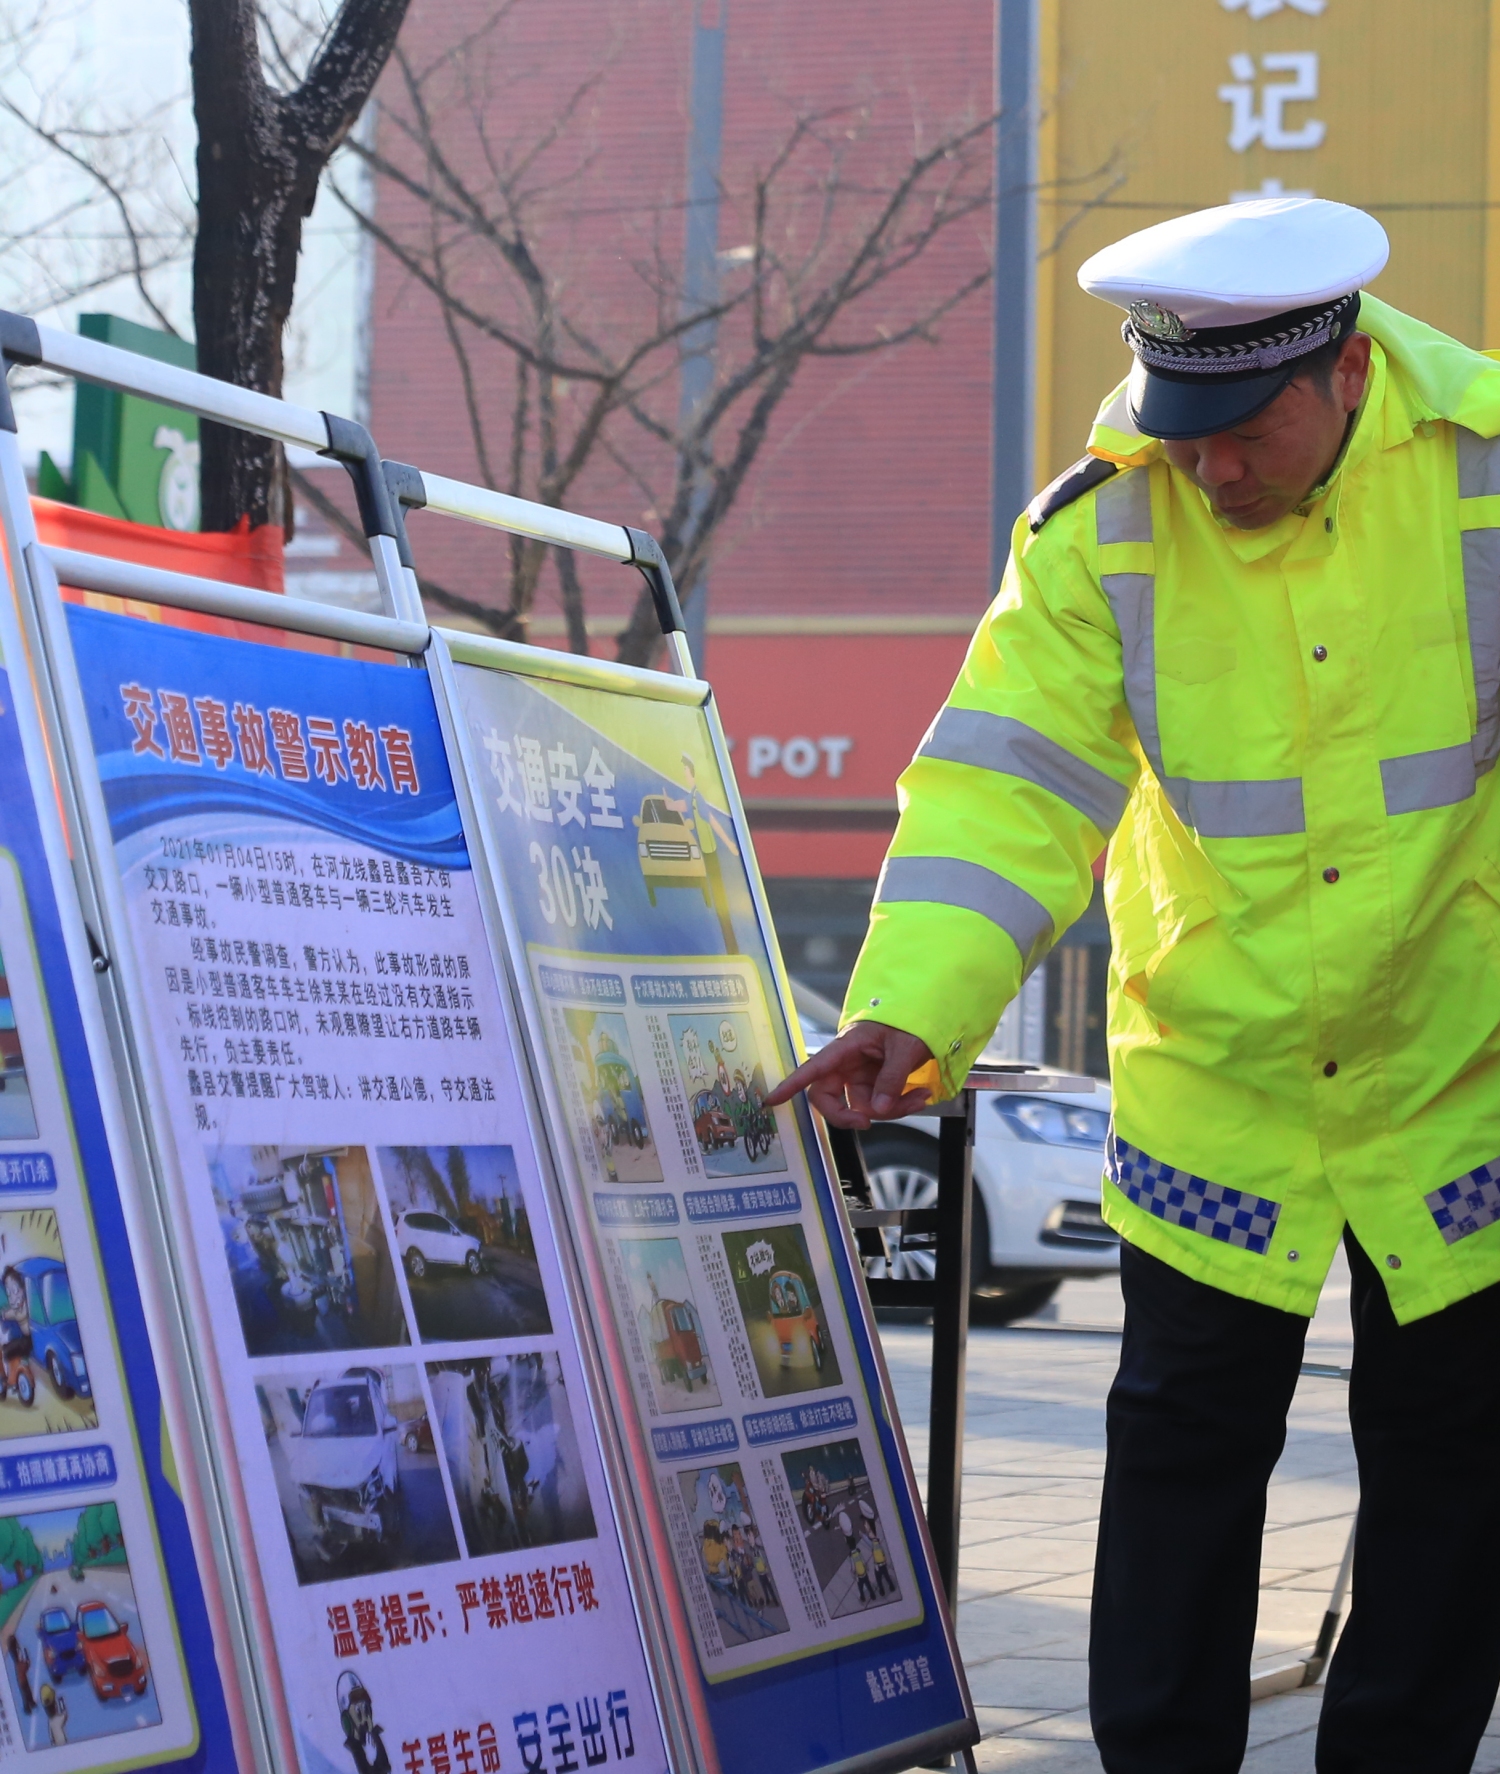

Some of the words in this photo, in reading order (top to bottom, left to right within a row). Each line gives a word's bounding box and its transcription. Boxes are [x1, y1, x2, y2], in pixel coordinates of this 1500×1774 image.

[121, 683, 420, 796] 交通事故警示教育
[482, 727, 624, 830] 交通安全
[747, 735, 855, 779] POT
[529, 841, 613, 932] 30诀
[326, 1560, 599, 1659] 温馨提示：严禁超速行驶
[865, 1655, 935, 1704] 蠡县交警宣
[512, 1688, 636, 1774] 安全出行
